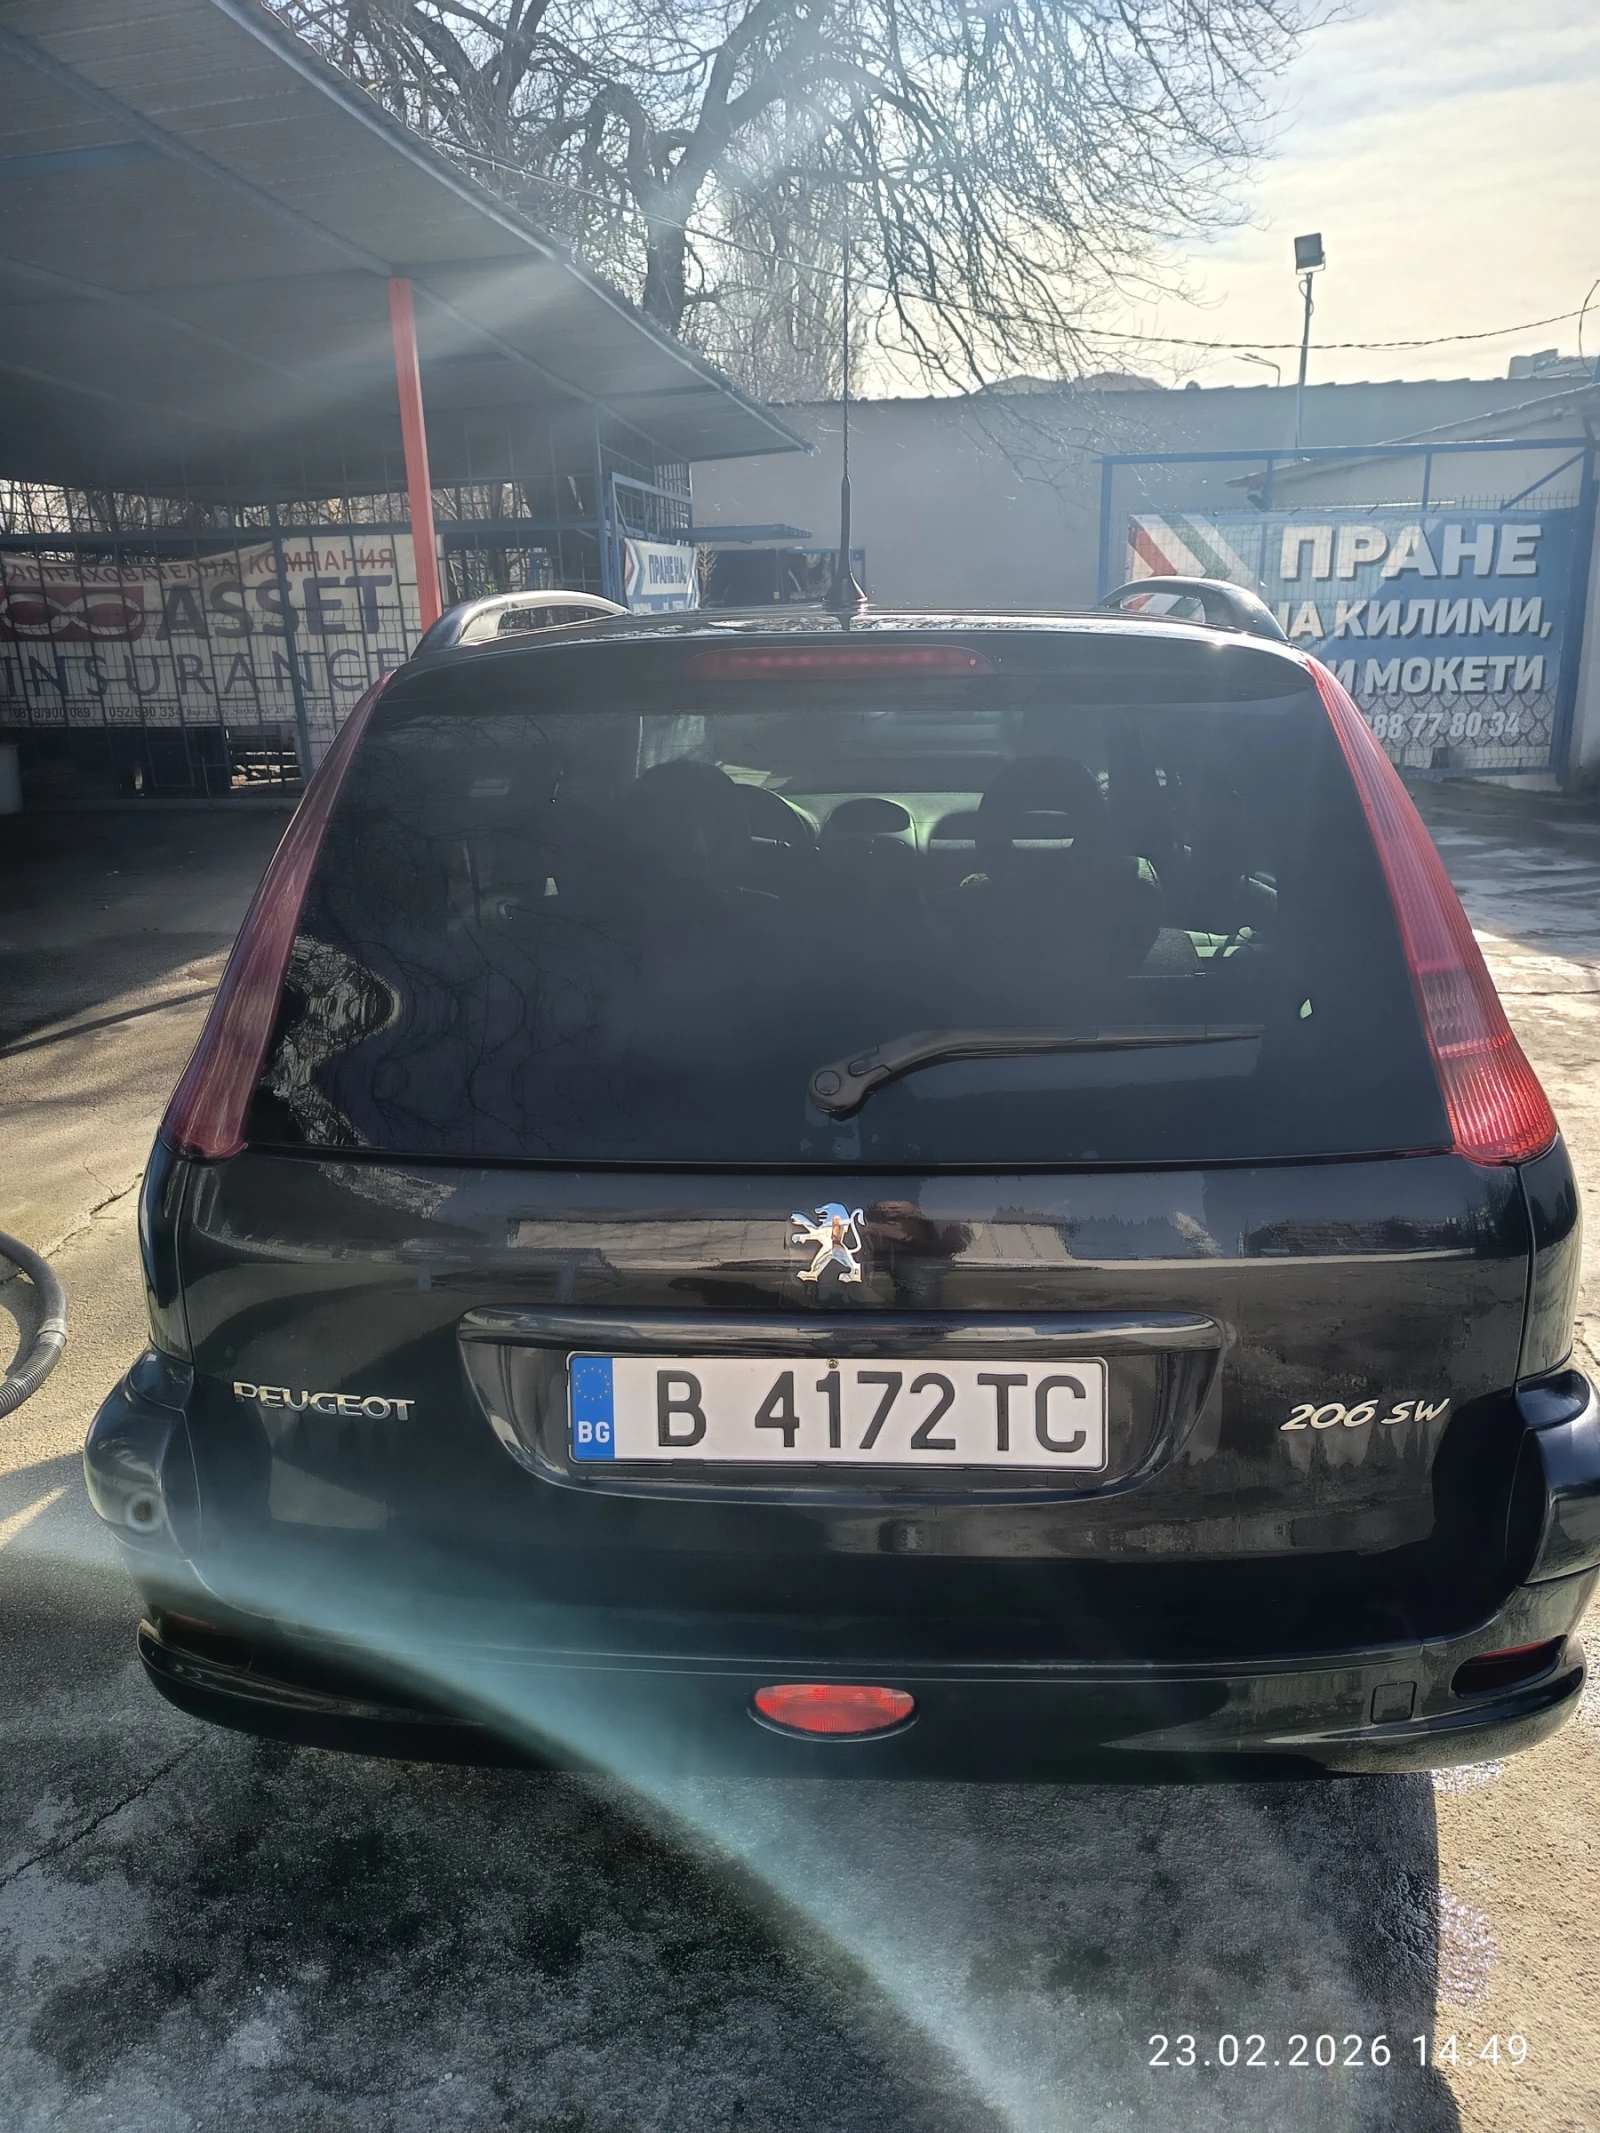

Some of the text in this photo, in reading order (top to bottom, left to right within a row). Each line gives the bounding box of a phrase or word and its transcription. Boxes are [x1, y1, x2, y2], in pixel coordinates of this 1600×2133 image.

[0, 548, 394, 584] АСТРАХОВАТЕЛНА КОМПАНИЯ
[1280, 523, 1542, 579] ПРАНЕ
[155, 574, 393, 641] ASSET
[1267, 597, 1552, 638] НА КИЛИМИ,
[1327, 655, 1544, 695] И МОКЕТИ
[70, 707, 91, 718] 089
[1412, 713, 1444, 737] 77
[1449, 711, 1483, 738] 80
[1488, 710, 1521, 737] 34
[233, 1381, 415, 1421] PEUGEOT
[657, 1369, 1087, 1453] B 4172 TC
[1280, 1398, 1450, 1431] 206 SW
[577, 1421, 611, 1444] BG
